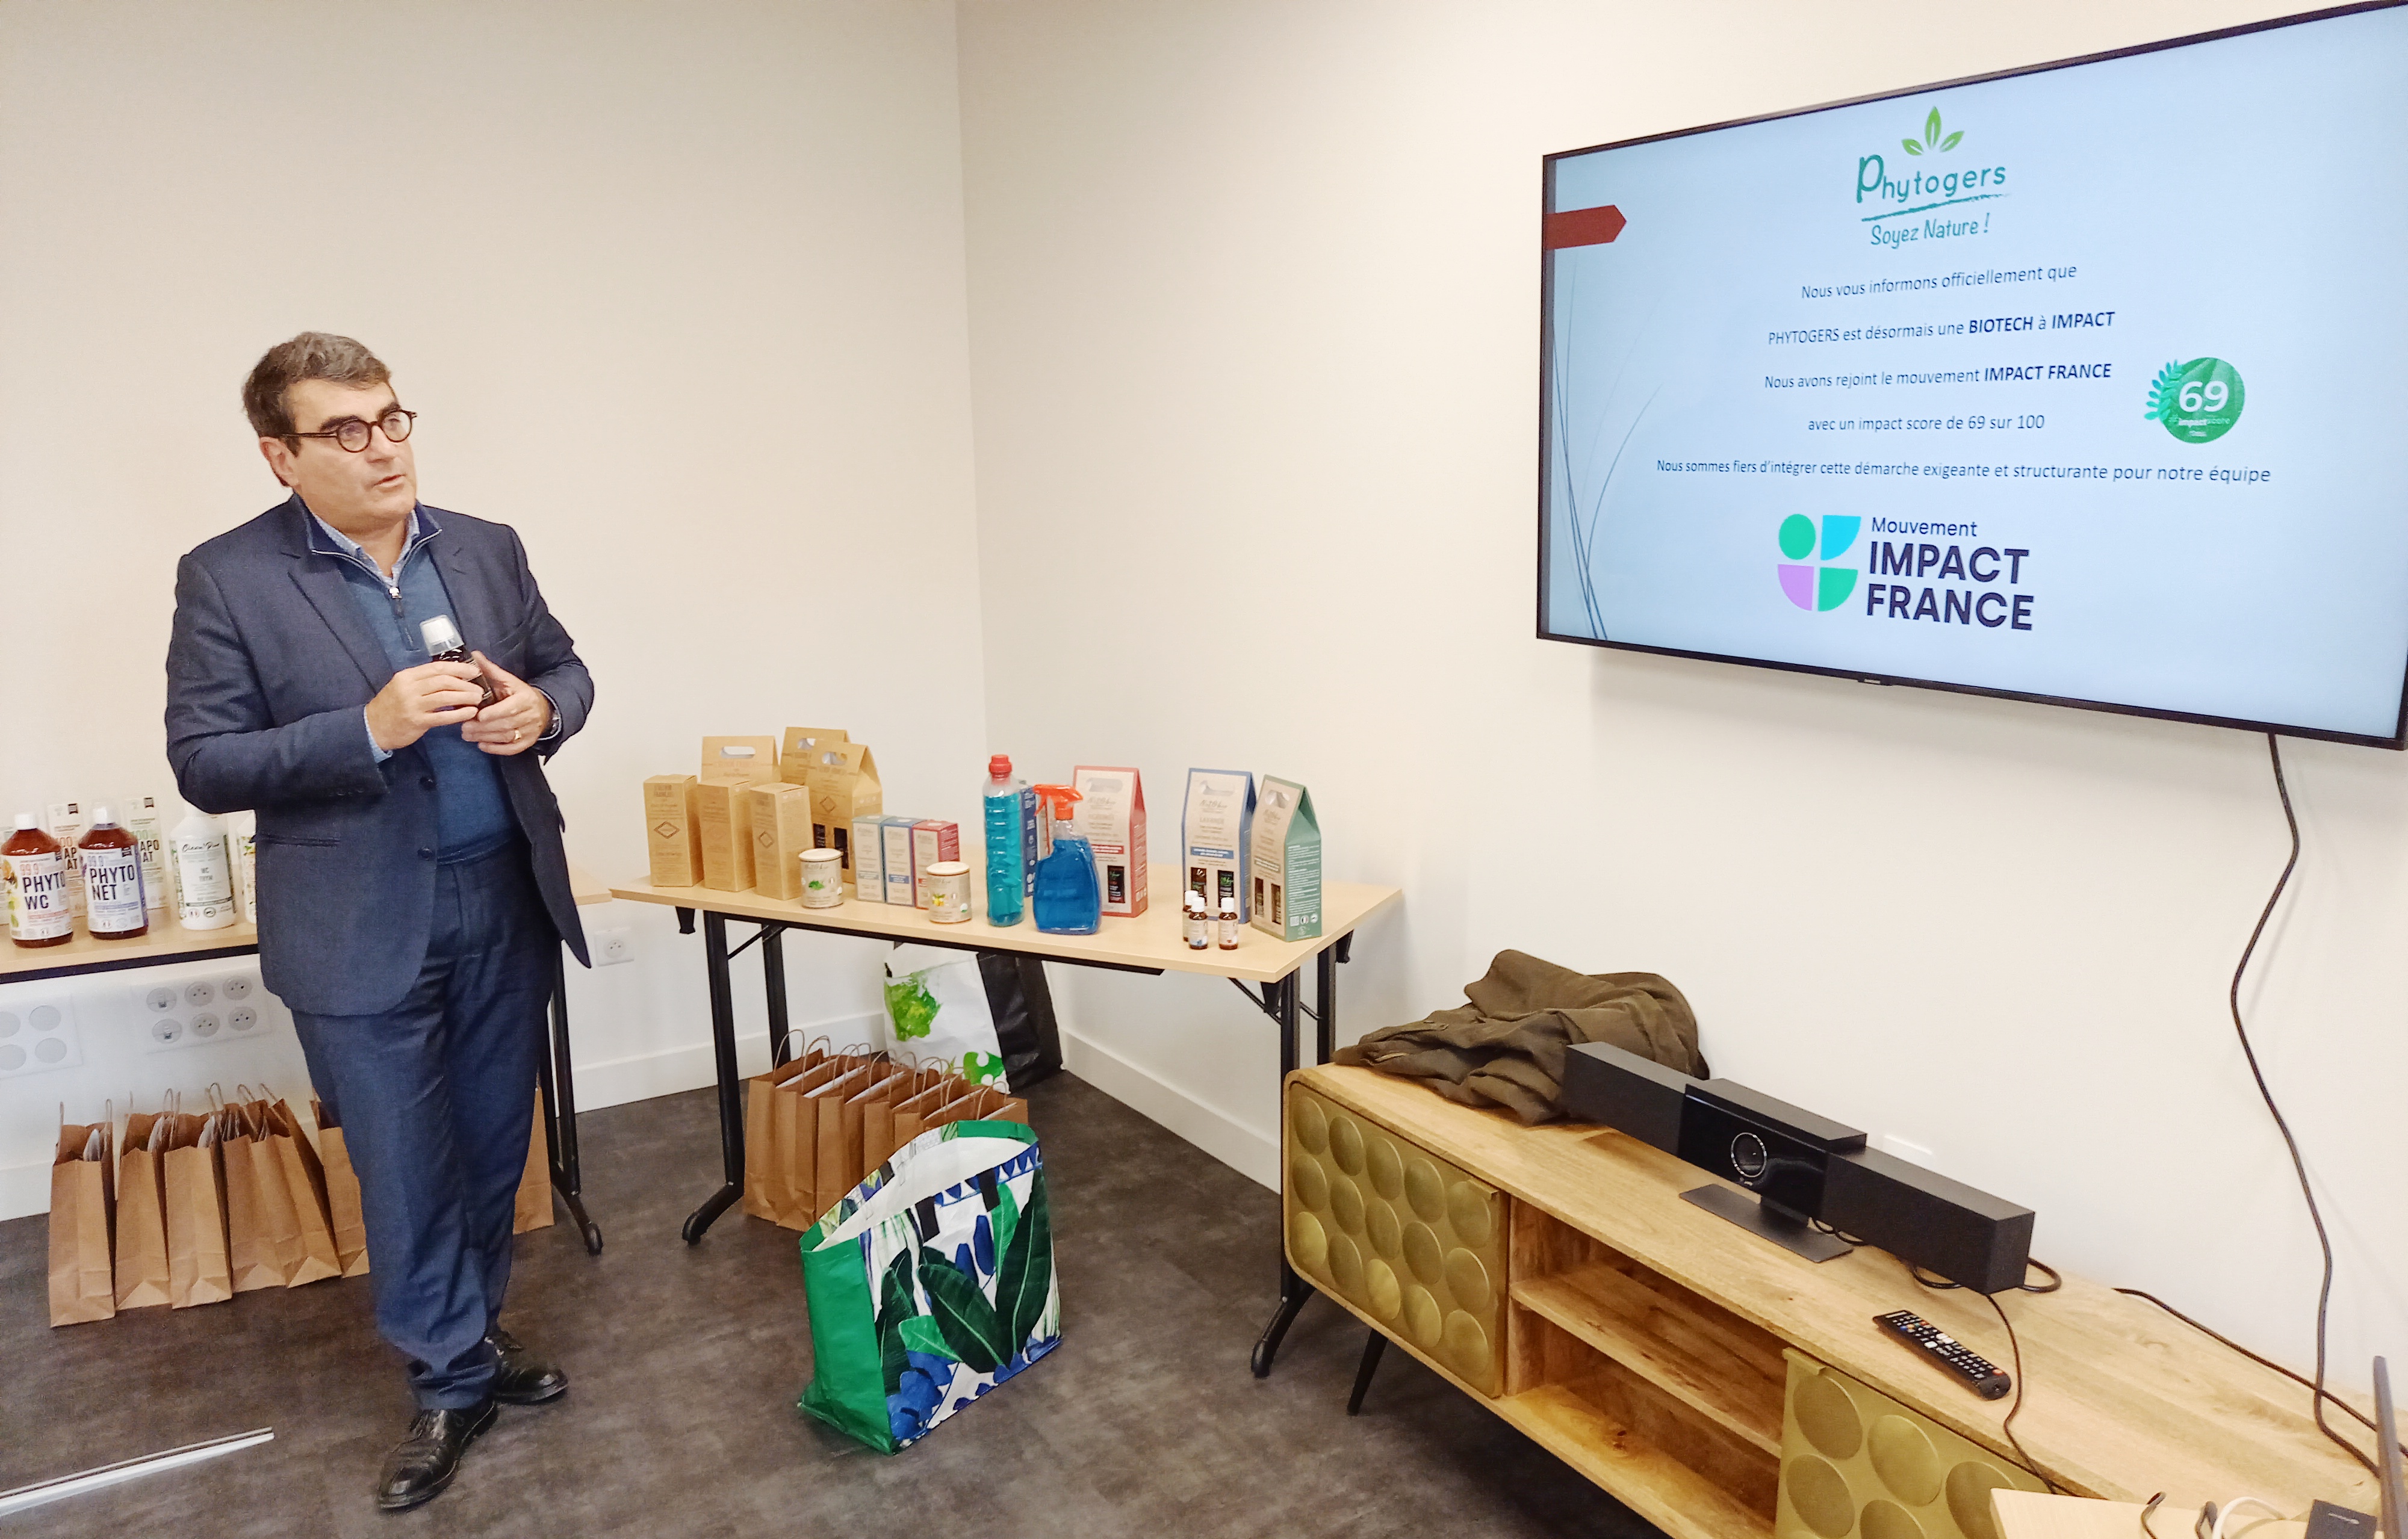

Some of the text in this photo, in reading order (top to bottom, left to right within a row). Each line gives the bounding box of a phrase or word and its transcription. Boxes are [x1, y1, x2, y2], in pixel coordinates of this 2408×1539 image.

[1856, 153, 2007, 204] Phytogers
[1870, 212, 1991, 249] Soyez Nature !
[1801, 266, 2077, 299] Nous vous informons officiellement que
[1768, 311, 2115, 345] PHYTOGERS est désormais une BIOTECH à IMPACT
[1764, 363, 2112, 389] Nous avons rejoint le mouvement IMPACT FRANCE
[2178, 380, 2229, 413] 69
[1808, 414, 2046, 433] avec un impact score de 69 sur 100
[1657, 459, 1683, 472] Nous
[1685, 461, 1730, 473] sommes
[1733, 459, 1757, 473] fiers
[1820, 462, 1851, 475] cette
[1854, 462, 1920, 476] démarche
[1923, 462, 1990, 479] exigeante
[1994, 464, 2009, 478] et
[2012, 465, 2108, 479] structurante
[2112, 467, 2153, 483] pour
[2156, 466, 2203, 482] notre
[2209, 465, 2271, 485] équipe
[1871, 516, 1978, 537] Mouvement
[1869, 541, 2030, 584] IMPACT
[1866, 583, 2035, 631] FRANCE
[22, 870, 66, 893] PHYTO
[90, 864, 135, 884] PHYTO
[25, 894, 49, 910] WC
[92, 883, 117, 901] NET
